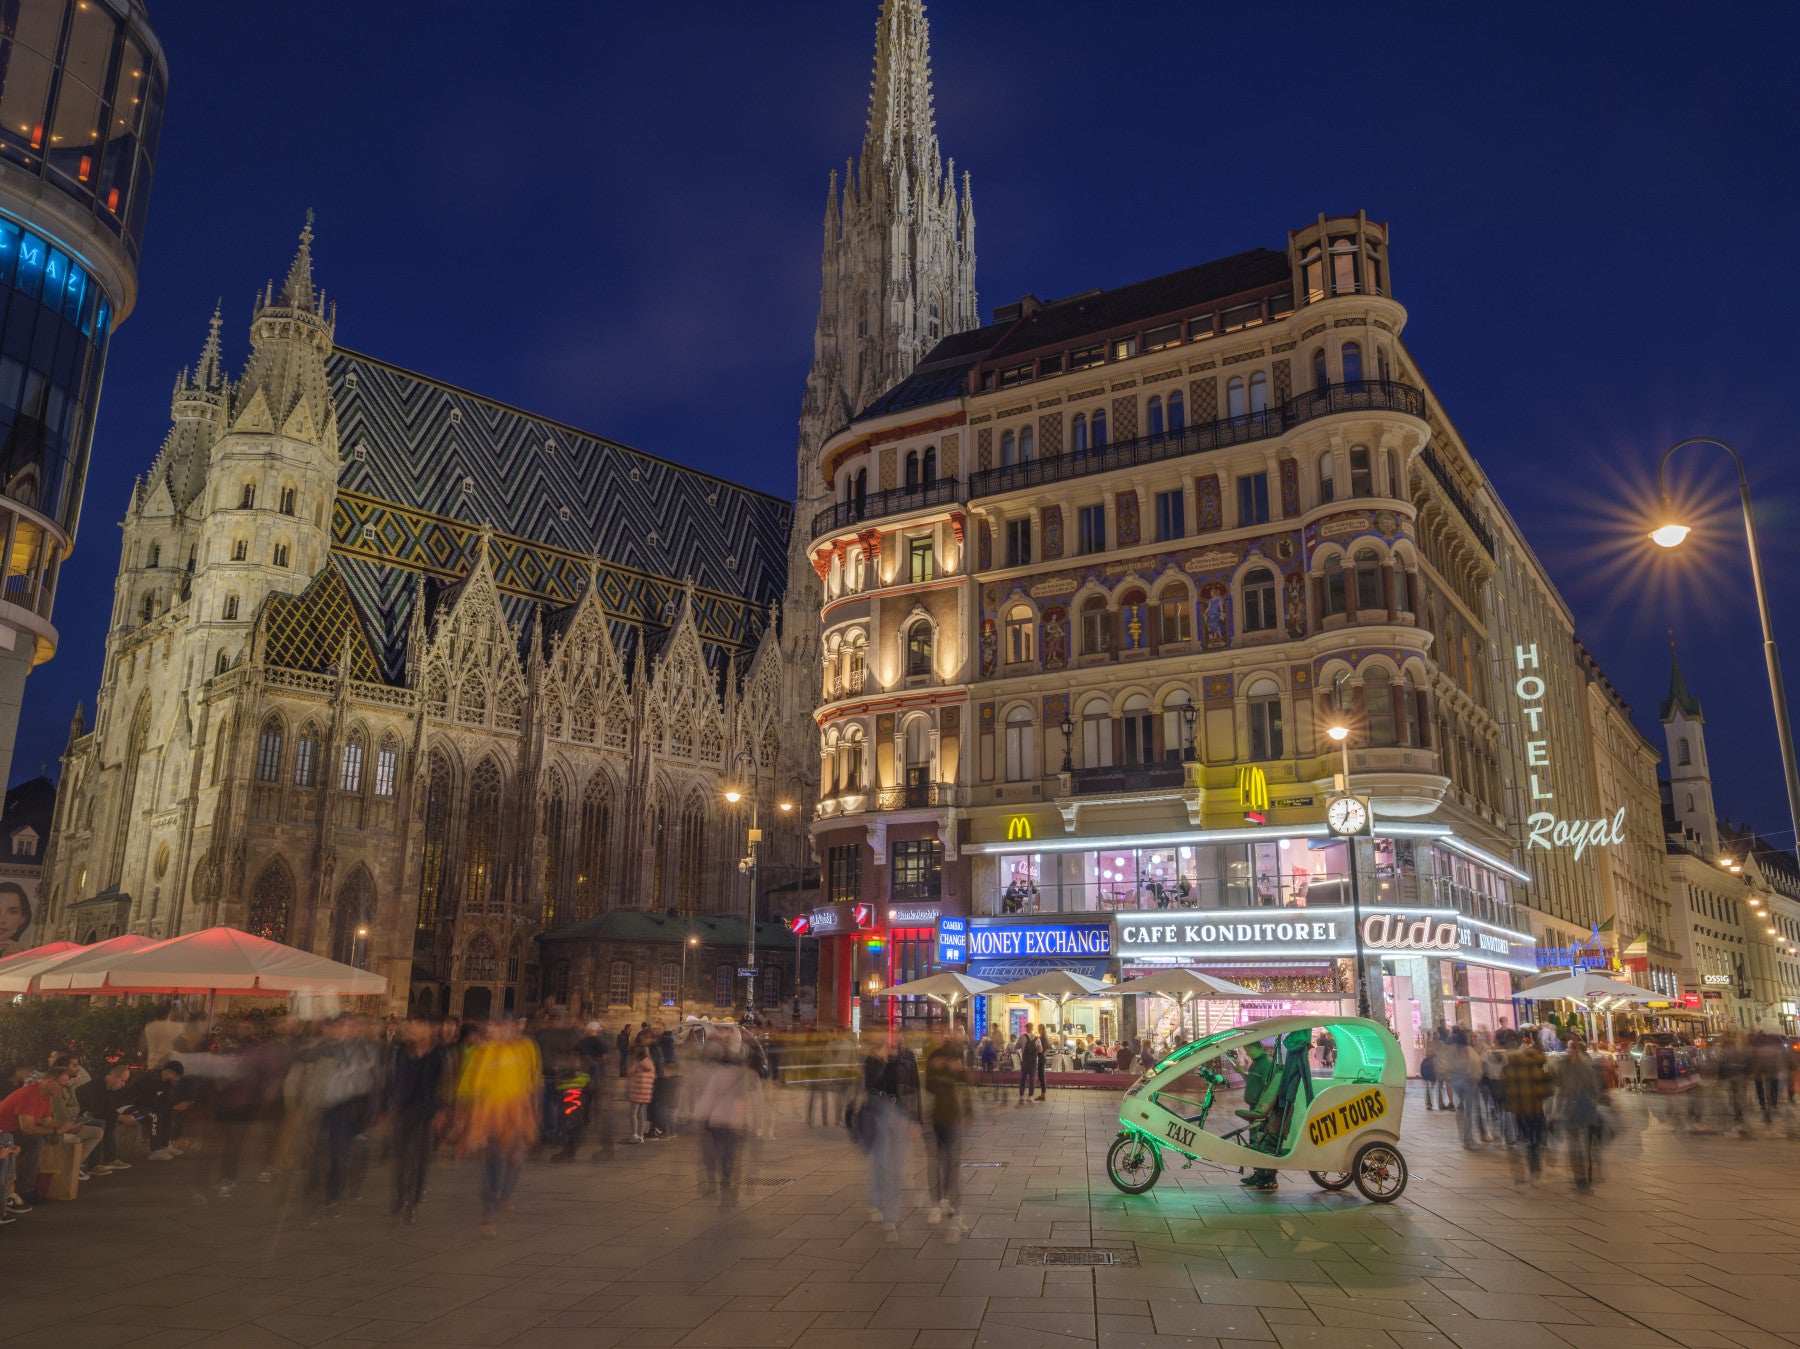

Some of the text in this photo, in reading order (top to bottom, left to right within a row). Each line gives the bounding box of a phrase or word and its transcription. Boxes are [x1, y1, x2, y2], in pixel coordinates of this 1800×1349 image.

[1516, 644, 1552, 800] HOTEL
[1527, 807, 1625, 862] Royal
[943, 920, 963, 931] CAMBIO
[1123, 922, 1337, 943] CAFÉ KONDITOREI
[940, 934, 966, 946] CHANGE
[969, 930, 1110, 954] MONEY EXCHANGE
[1309, 1090, 1385, 1146] CITY TOURS
[1167, 1120, 1198, 1148] TAXI
